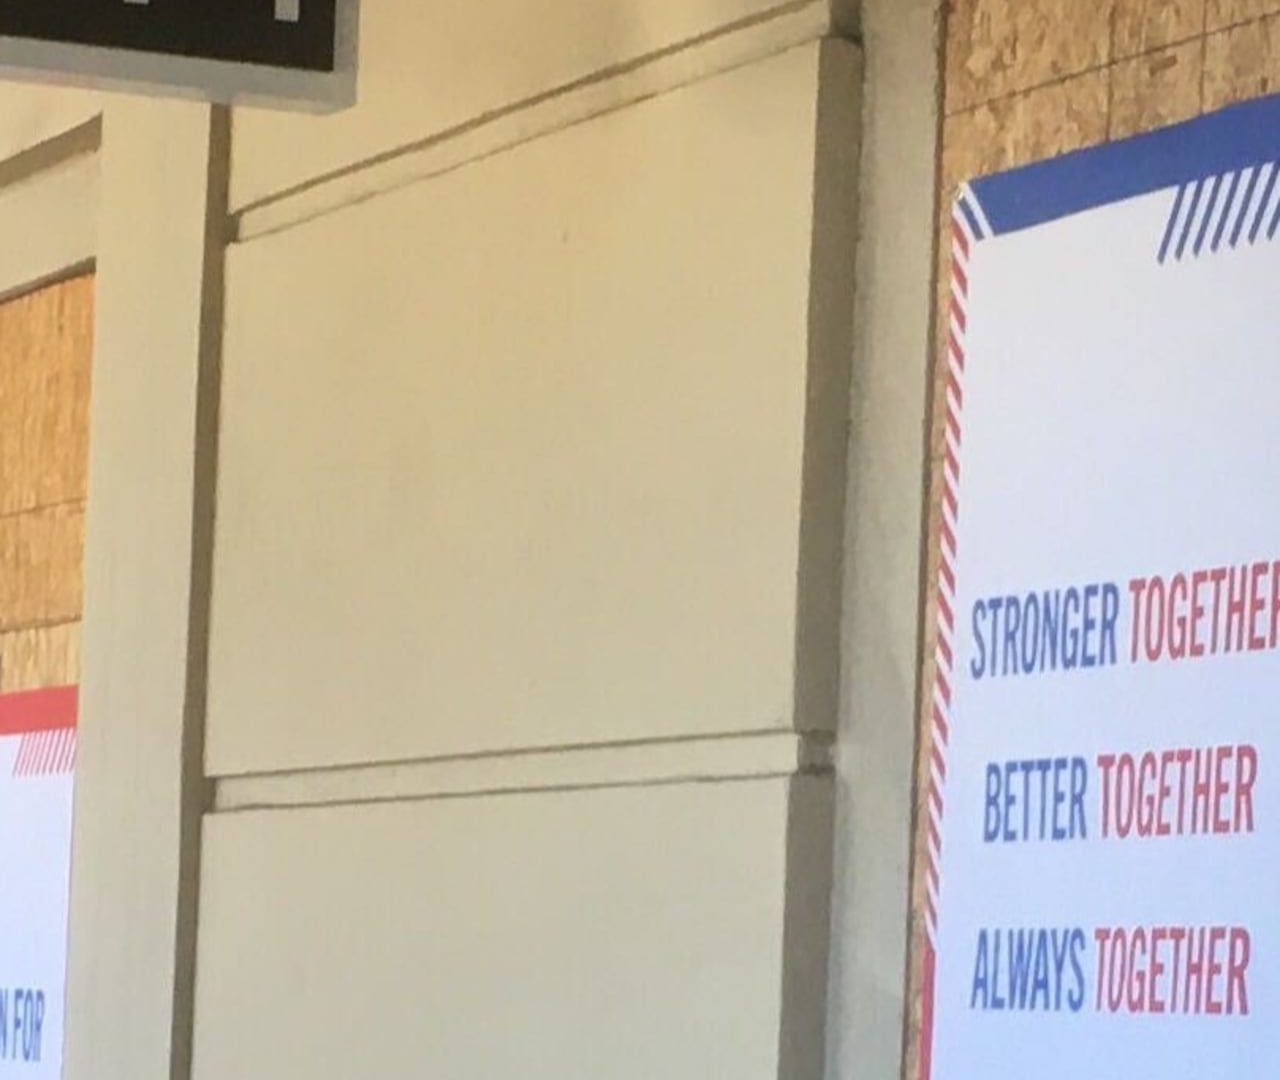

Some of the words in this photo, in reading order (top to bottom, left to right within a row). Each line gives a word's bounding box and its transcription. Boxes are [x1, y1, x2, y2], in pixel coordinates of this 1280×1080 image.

[971, 581, 1120, 681] STRONGER
[983, 756, 1088, 844] BETTER
[1096, 743, 1258, 840] TOGETHER
[969, 927, 1086, 1013] ALWAYS
[1094, 926, 1251, 1015] TOGETHER
[12, 989, 46, 1062] FOR
